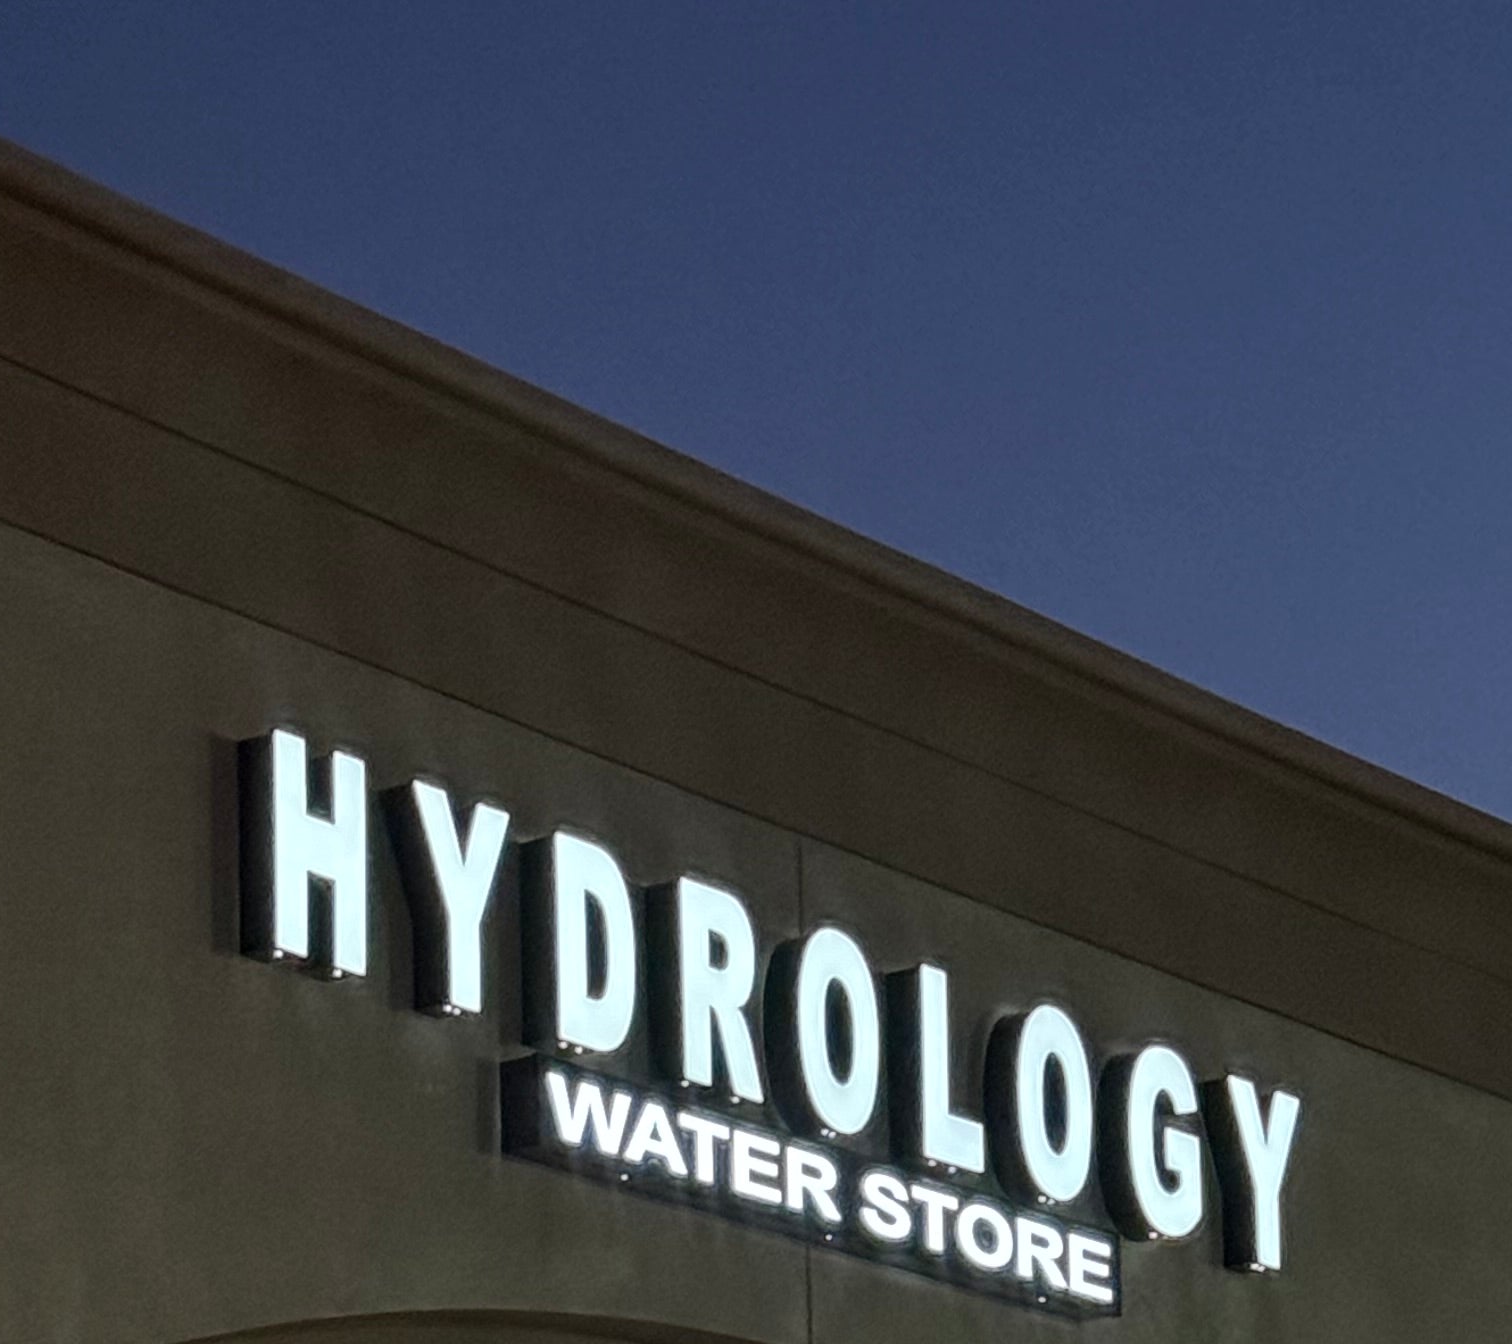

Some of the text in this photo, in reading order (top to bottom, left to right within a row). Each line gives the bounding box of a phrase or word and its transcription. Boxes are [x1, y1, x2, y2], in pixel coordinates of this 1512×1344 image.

[271, 728, 1301, 1272] HYDROLOGY
[545, 1069, 1115, 1307] WATER STORE
